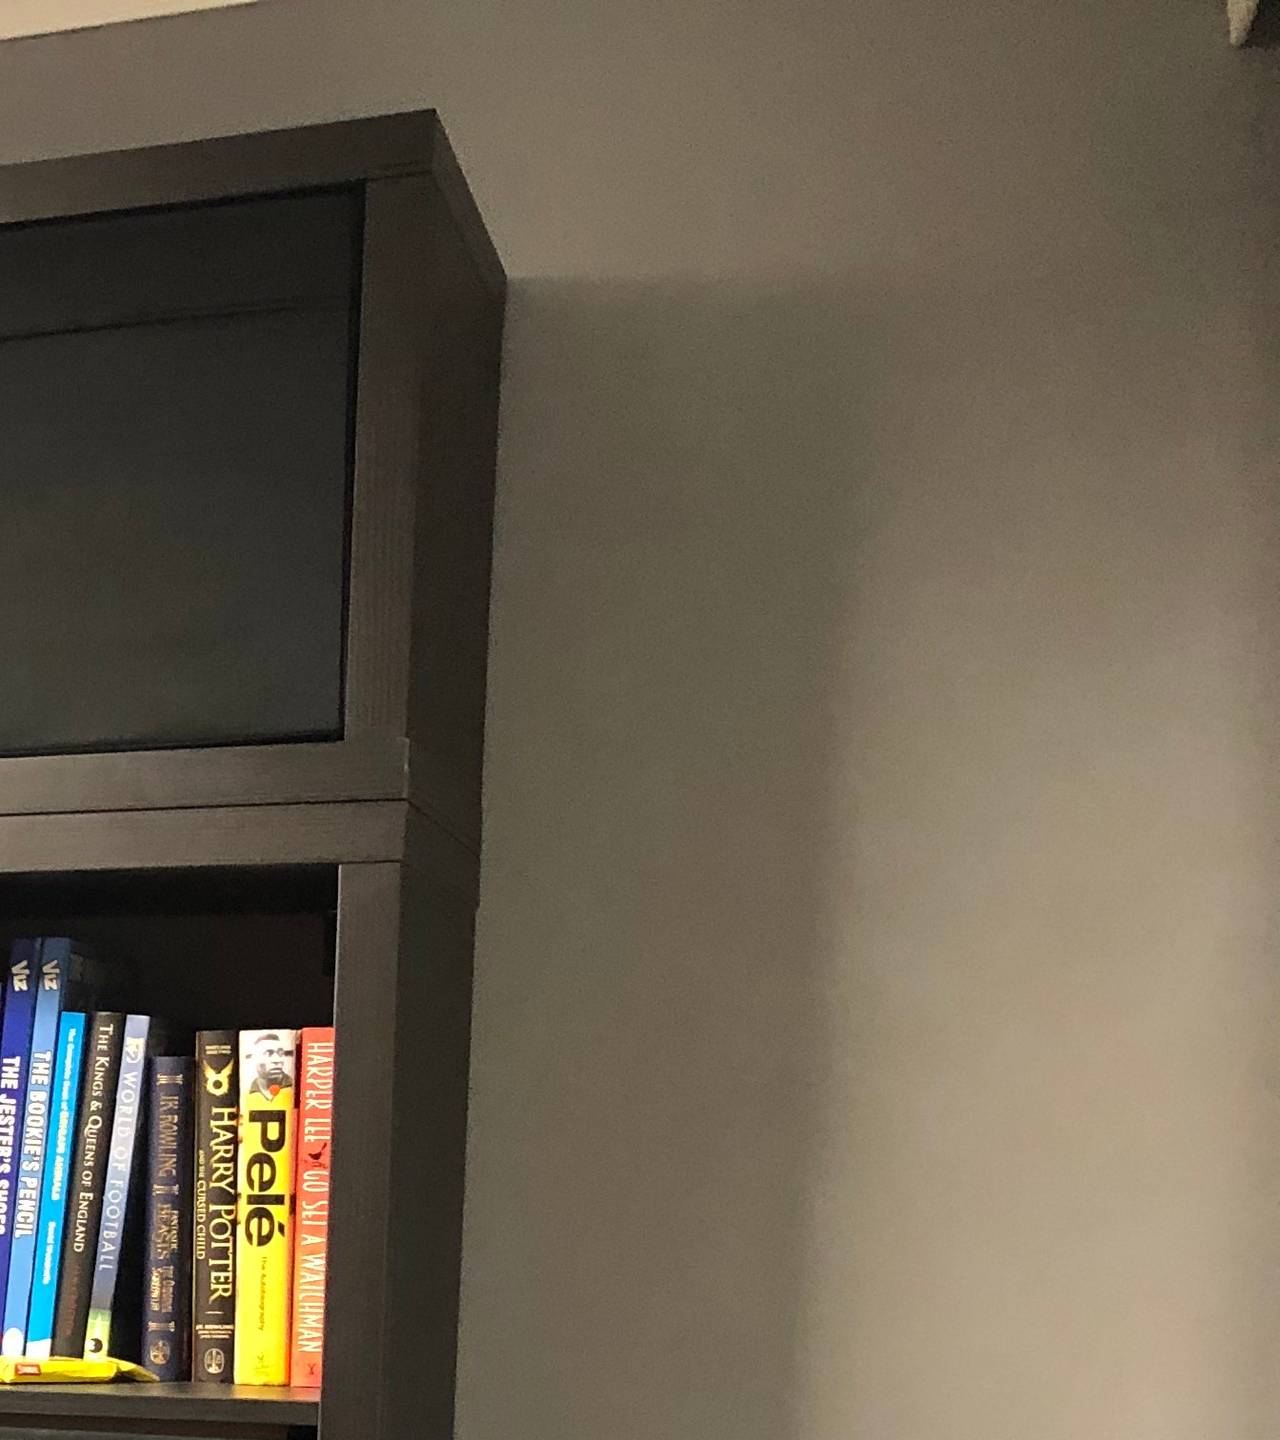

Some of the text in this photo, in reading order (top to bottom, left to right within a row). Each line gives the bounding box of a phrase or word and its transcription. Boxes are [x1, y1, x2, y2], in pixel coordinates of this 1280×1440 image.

[1, 1056, 21, 1089] THE
[90, 1100, 102, 1111] &
[14, 1051, 52, 1240] THE BOOKIE'S PENCIL
[99, 1071, 139, 1272] WORLD OF FOOTBALL
[207, 1105, 237, 1195] HARRY
[244, 1109, 287, 1247] Pelé
[196, 1179, 207, 1259] CURSED CHILD
[297, 1042, 334, 1354] HARPER LEE GO SET A WATCHMAN
[207, 1205, 237, 1305] POTTER
[257, 1256, 269, 1331] The Autobiography
